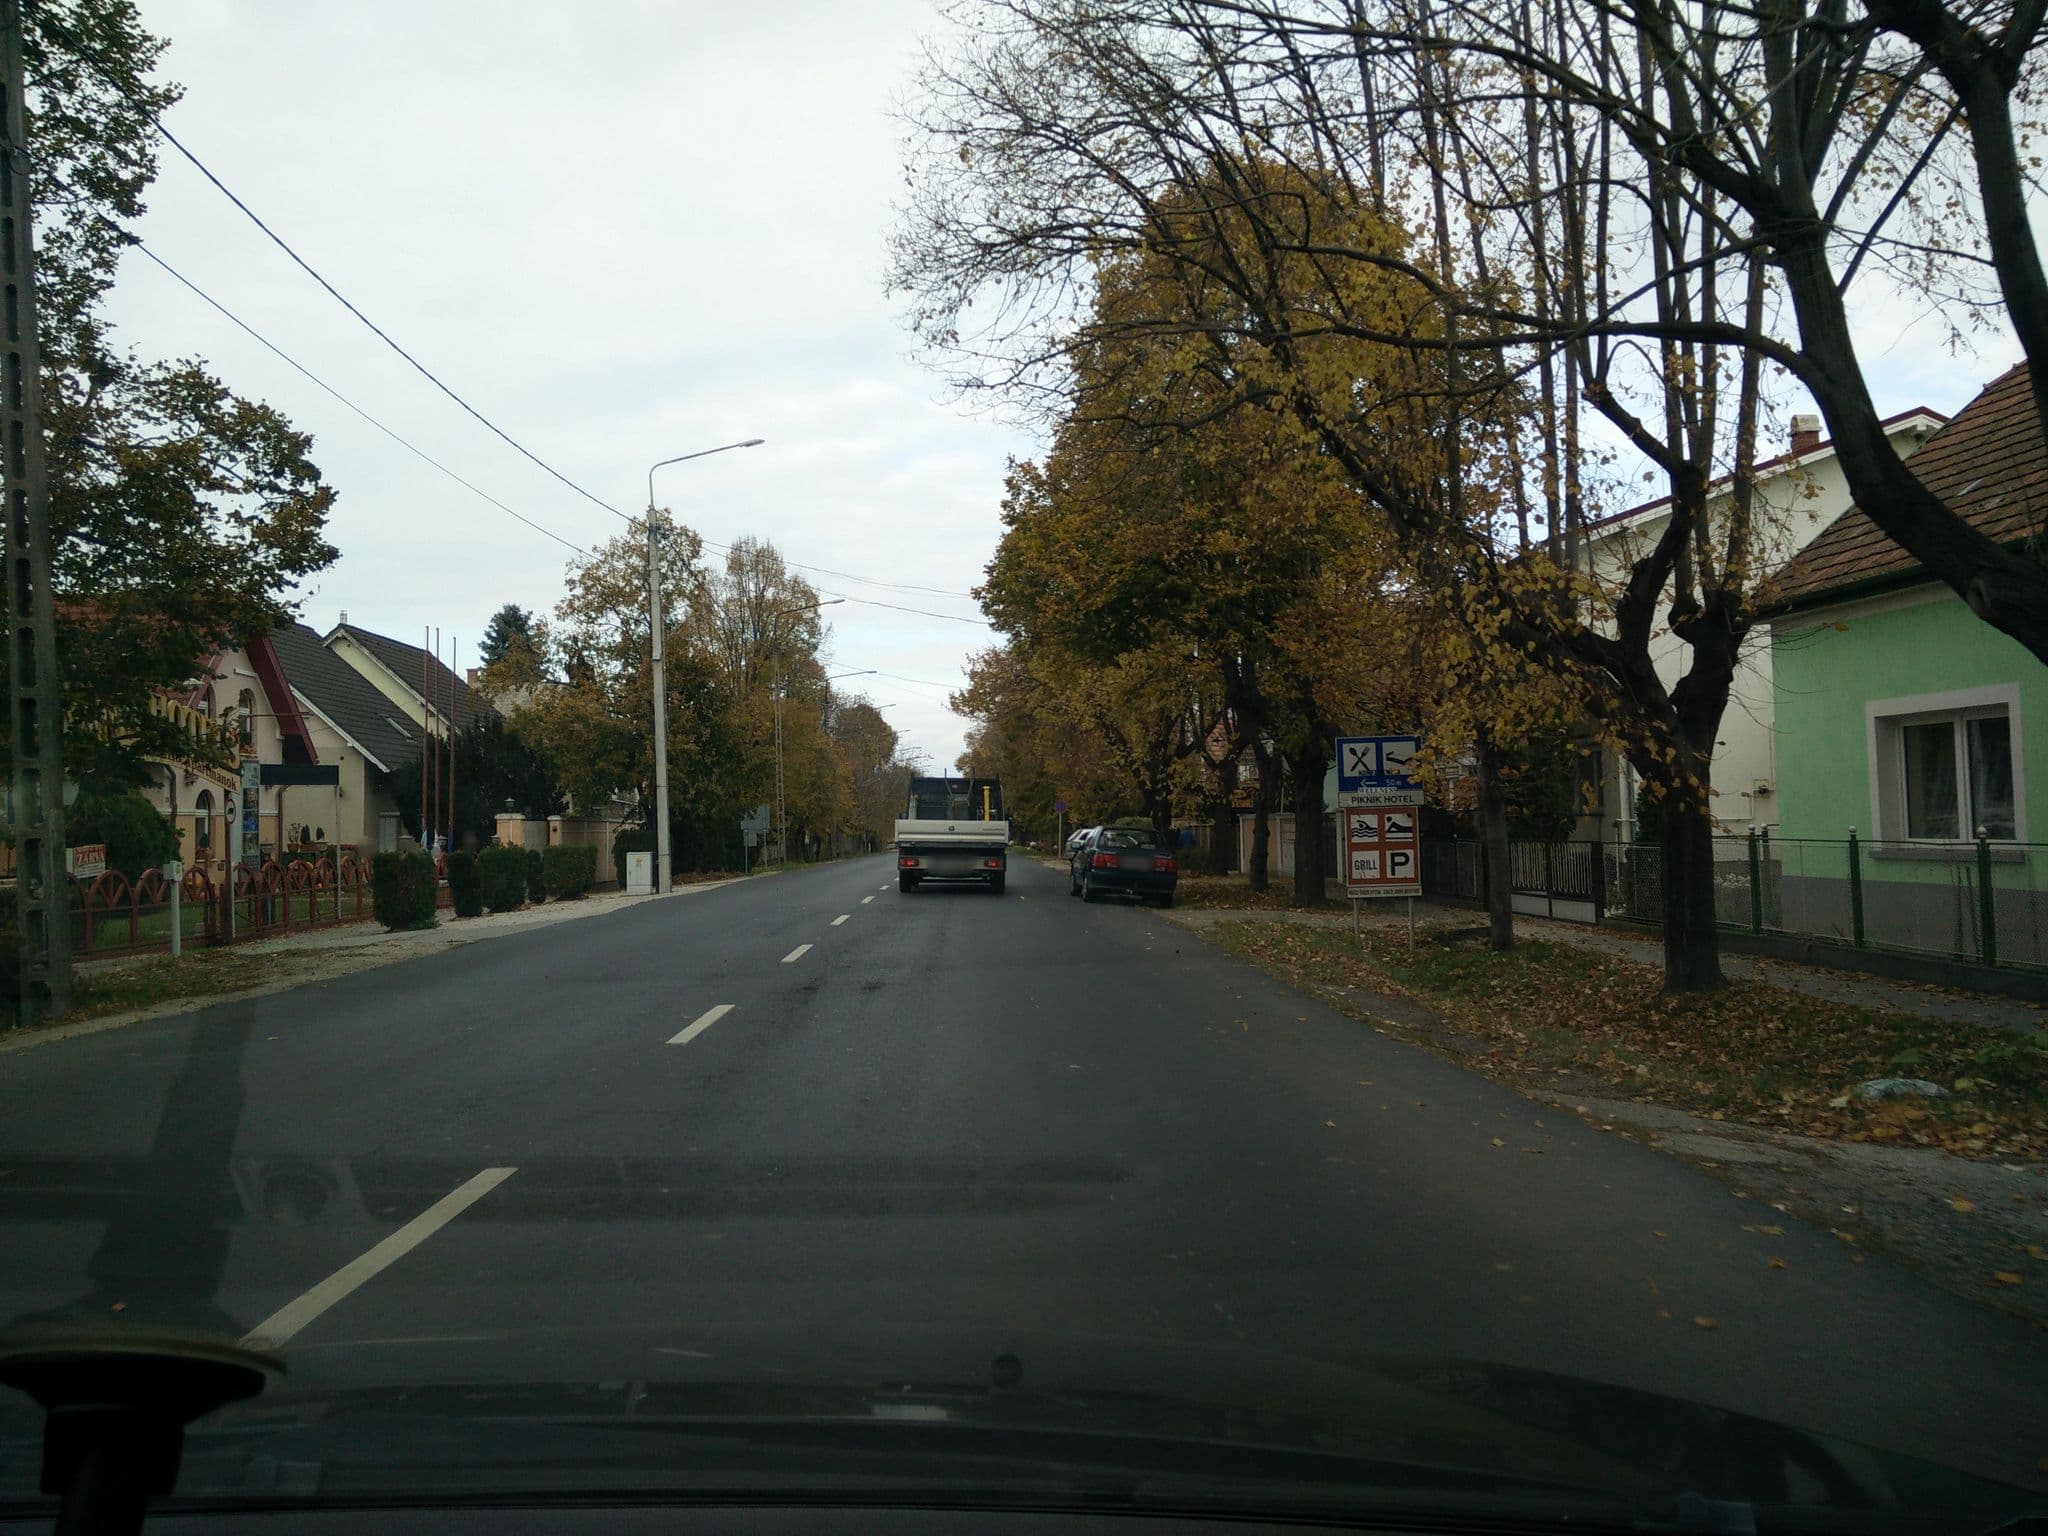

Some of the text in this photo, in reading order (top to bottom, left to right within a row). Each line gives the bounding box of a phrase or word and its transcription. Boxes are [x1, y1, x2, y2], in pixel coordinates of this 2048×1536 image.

[1352, 795, 1414, 804] PIKNIK HOTEL
[1354, 852, 1410, 876] GRILL P
